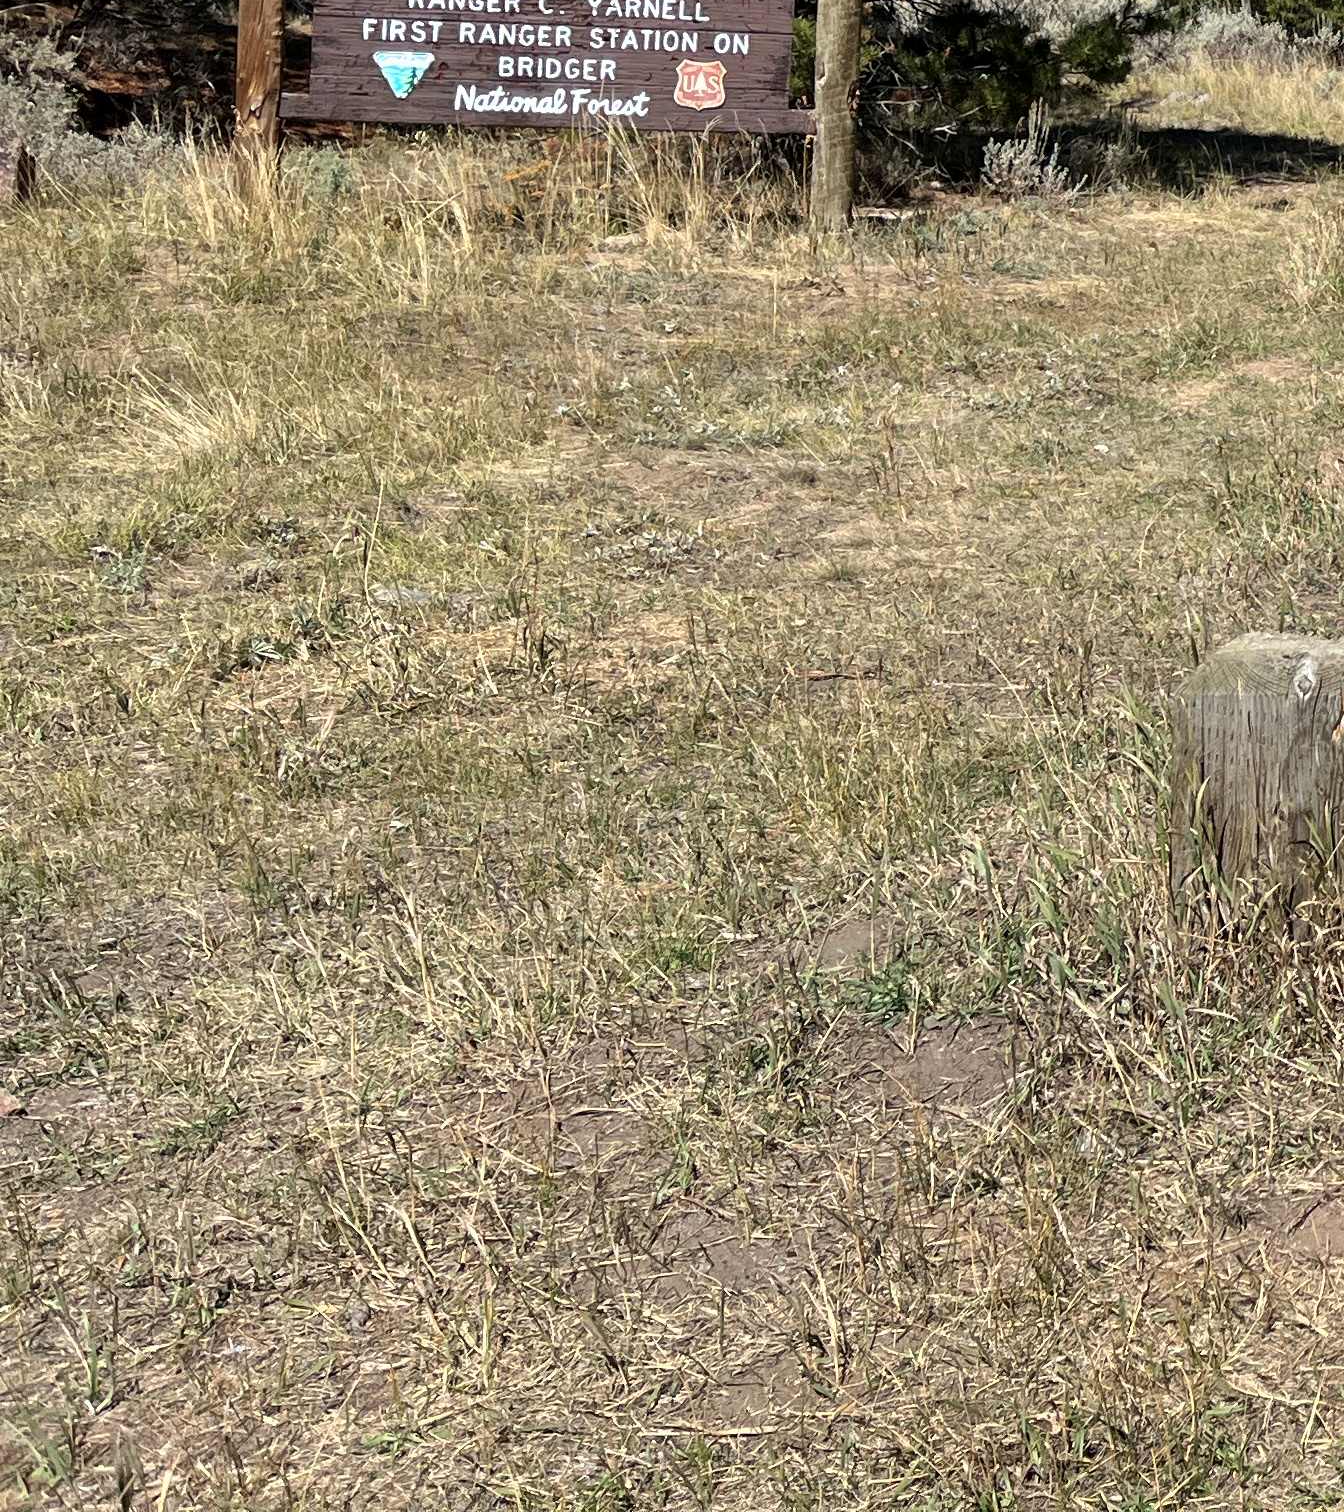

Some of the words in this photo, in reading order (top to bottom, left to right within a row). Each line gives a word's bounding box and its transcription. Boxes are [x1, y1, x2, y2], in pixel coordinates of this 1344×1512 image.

[362, 18, 443, 43] FIRST
[459, 22, 572, 47] RANGER
[589, 27, 698, 53] STATION
[713, 33, 750, 56] ON
[498, 56, 617, 81] BRIDGER
[454, 84, 568, 115] National
[570, 88, 650, 117] Forest
